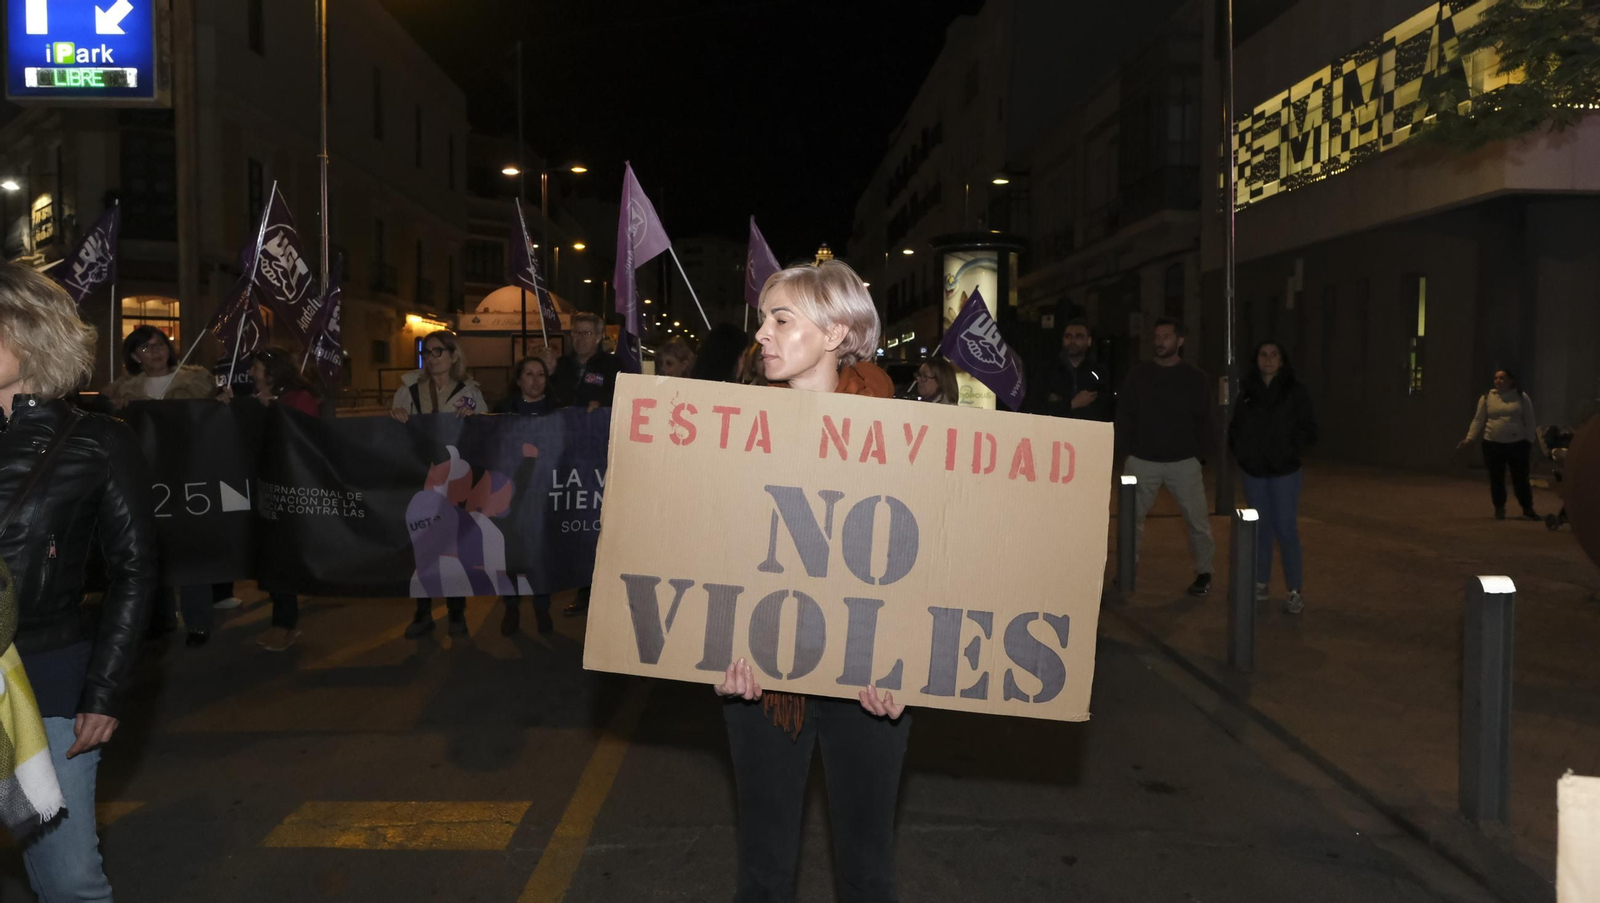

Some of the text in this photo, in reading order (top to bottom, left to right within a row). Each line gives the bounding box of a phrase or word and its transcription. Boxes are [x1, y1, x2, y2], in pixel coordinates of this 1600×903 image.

[53, 69, 105, 87] LIBRE
[264, 230, 310, 287] UGT
[297, 294, 326, 334] Andalu
[967, 312, 1008, 357] UGT
[630, 397, 1076, 485] ESTA NAVIDAD
[552, 468, 606, 489] LA V
[322, 497, 338, 507] DE
[343, 500, 357, 508] LA
[346, 492, 362, 501] DE
[548, 490, 603, 511] TIEN
[287, 504, 339, 516] CONTRA
[343, 508, 365, 518] LAS
[410, 517, 431, 531] UGT
[757, 485, 920, 586] NO
[619, 573, 1070, 704] VIOLES
